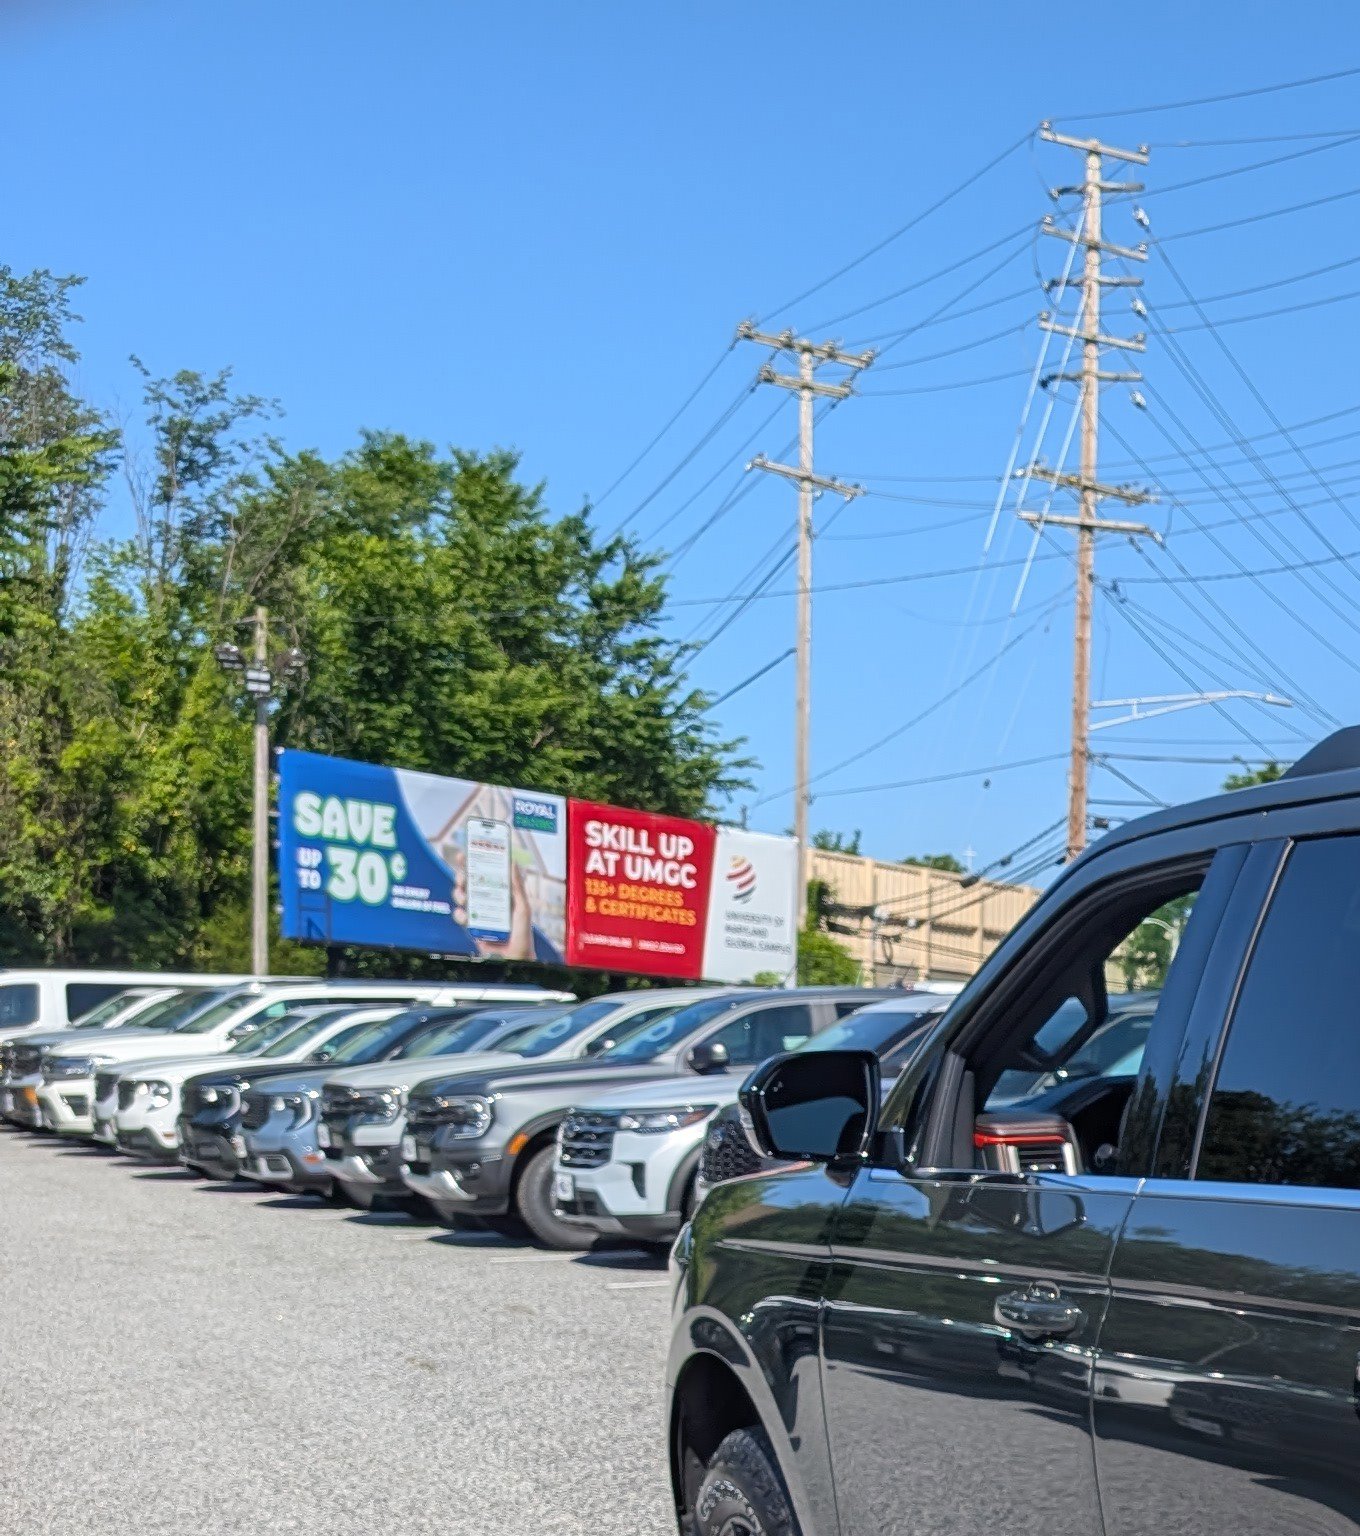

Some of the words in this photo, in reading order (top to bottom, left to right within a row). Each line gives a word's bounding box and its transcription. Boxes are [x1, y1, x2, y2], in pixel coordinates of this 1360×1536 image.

[294, 791, 397, 848] SAVE
[515, 800, 556, 820] ROYAL
[585, 820, 655, 855] SKILL
[658, 832, 694, 860] UP
[297, 847, 322, 868] UP
[585, 849, 620, 877] AT
[624, 855, 698, 889] UMGC
[298, 867, 322, 889] TO
[618, 883, 684, 907] DEGREES
[585, 896, 597, 913] &
[599, 899, 698, 926] CERTIFICATES
